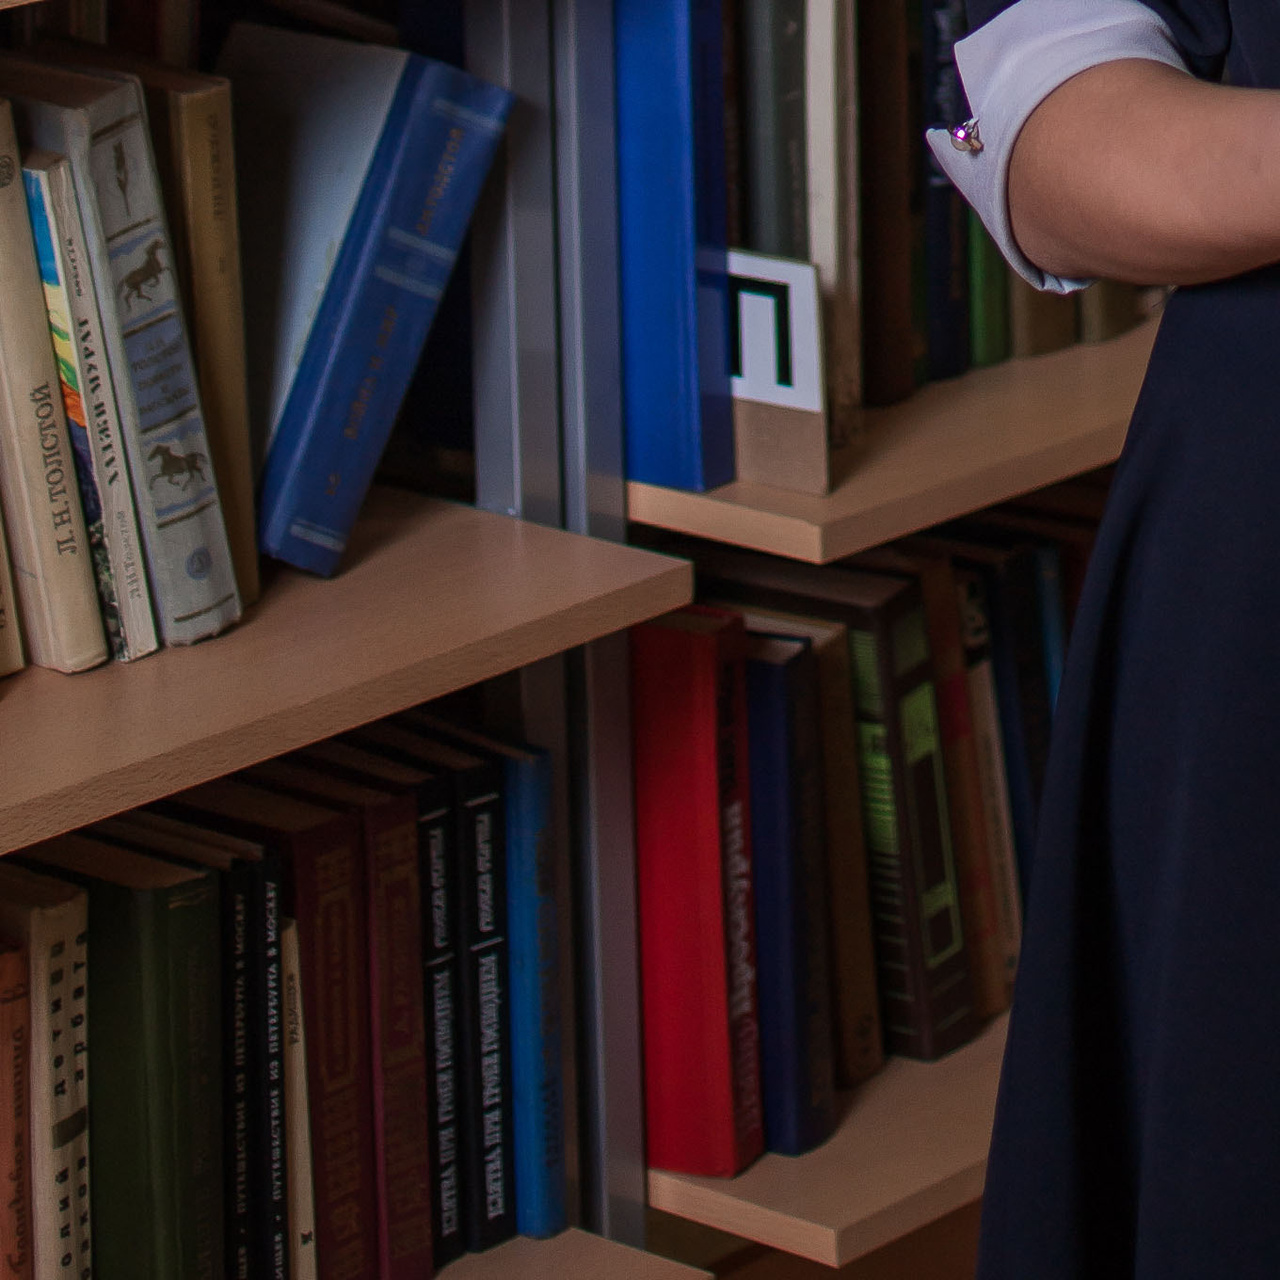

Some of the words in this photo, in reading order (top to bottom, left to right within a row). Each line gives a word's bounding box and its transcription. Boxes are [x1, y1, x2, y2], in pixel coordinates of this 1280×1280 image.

[729, 276, 791, 386] П
[77, 316, 120, 487] ХАДЖИ-МУРАТ
[234, 894, 246, 955] МОСКВУ
[265, 881, 279, 944] МОСКВУ
[234, 977, 246, 1066] ПЕТЕРБУРГА
[267, 962, 280, 1053] ПЕТЕРБУРГА
[268, 1059, 280, 1081] ИЗ
[235, 1101, 248, 1214] ПУТЕШЕСТВИЕ
[270, 1088, 283, 1202] ПУТЕШЕСТВИЕ
[484, 1145, 505, 1220] КЛЯТВА
[440, 1163, 458, 1237] КЛЯТВА
